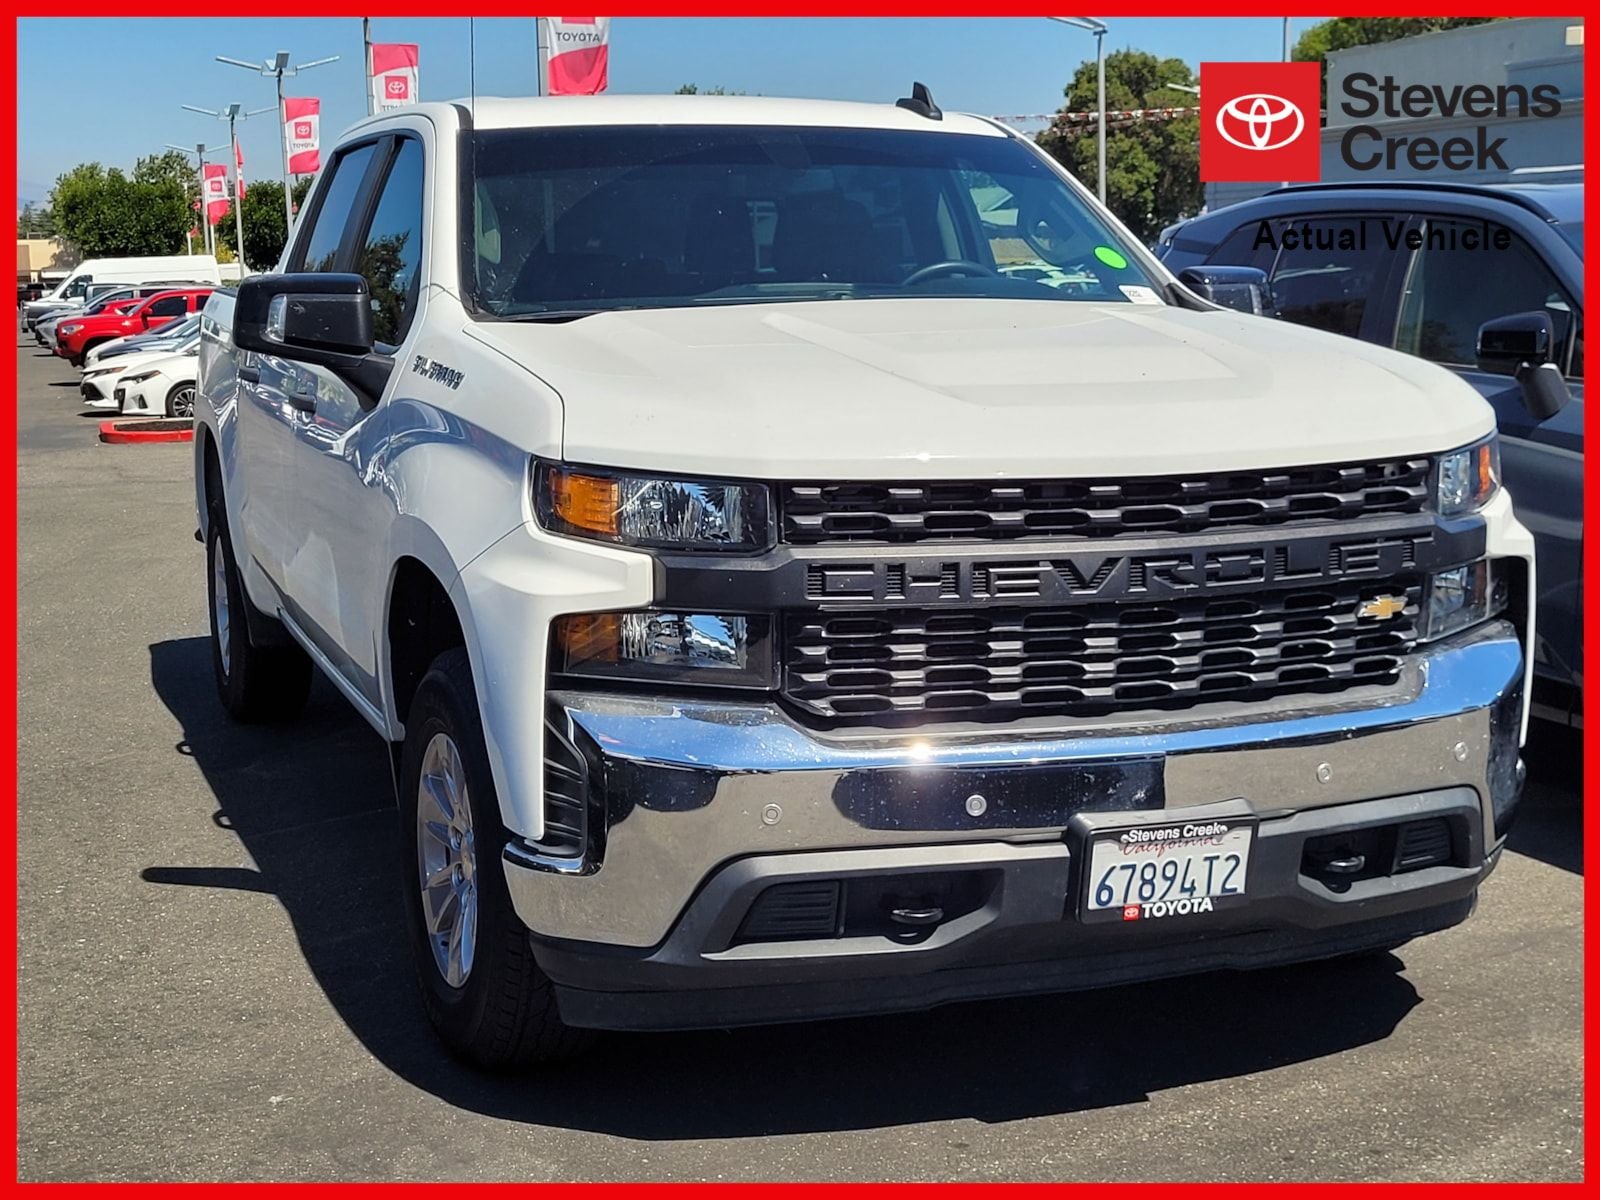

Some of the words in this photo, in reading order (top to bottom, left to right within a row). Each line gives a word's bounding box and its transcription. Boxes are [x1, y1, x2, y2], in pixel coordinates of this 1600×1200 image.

[556, 31, 600, 42] TOYOTA
[292, 142, 315, 150] TOYOTA
[805, 535, 1434, 600] CHEVROLET
[1128, 827, 1180, 844] Stevens
[1183, 822, 1221, 838] Creek
[1095, 853, 1241, 907] 67894T2
[1142, 897, 1214, 919] TOYOTA
